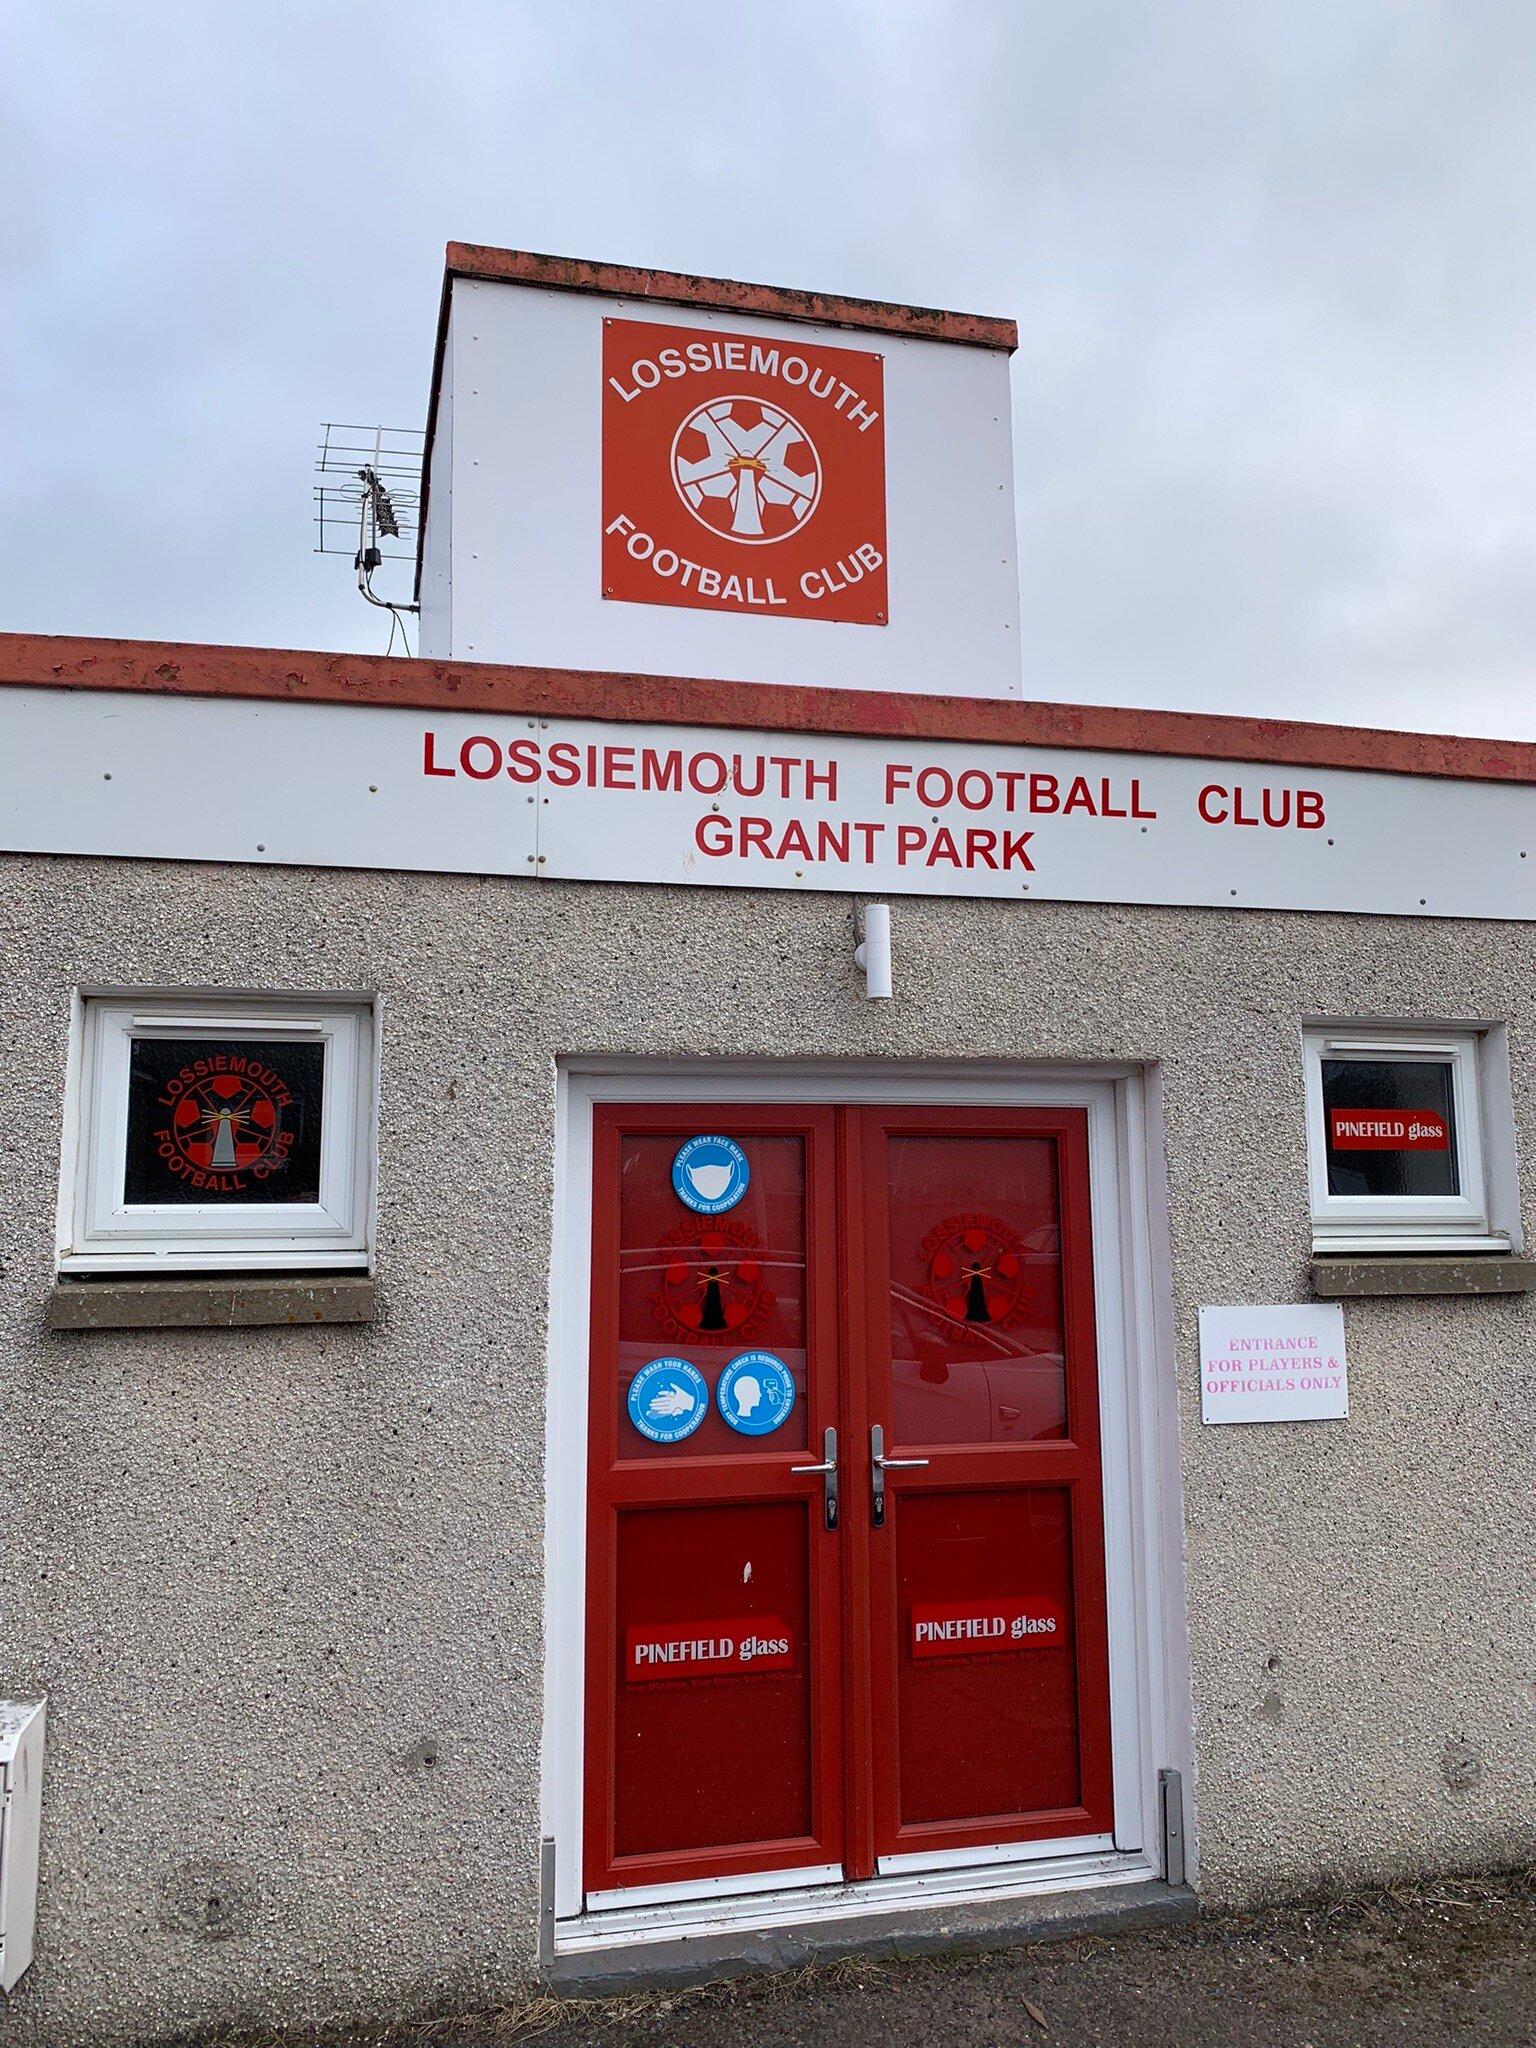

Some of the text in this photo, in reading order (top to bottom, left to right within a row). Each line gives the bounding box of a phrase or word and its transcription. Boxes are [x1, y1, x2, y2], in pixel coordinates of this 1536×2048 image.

[608, 342, 879, 432] LOSSIEMOUTH
[605, 514, 884, 605] FOOTBALL CLUB
[423, 732, 1326, 829] LOSSIEMOUTH FOOTBALL CLUB
[694, 813, 1036, 872] GRANT PARK
[158, 1056, 293, 1107] LOSSIEMOUTH
[1336, 1122, 1443, 1140] PINEFIELD glass
[153, 1129, 295, 1191] FOOTBALL CLUB
[676, 1137, 744, 1168] PLEASE WEAR FACE MASK
[678, 1182, 746, 1212] THANKS FOR COOPERATION
[914, 1211, 1029, 1262] OSSIEMO
[1228, 1336, 1318, 1351] ENTRANCE
[630, 1360, 702, 1402] PLEASE WASH YOUR HANDS
[731, 1355, 750, 1370] CHECK
[757, 1354, 784, 1372] REQUIRED
[786, 1389, 793, 1398] TO
[1206, 1376, 1342, 1393] OFFICIALS ONLY
[1207, 1356, 1339, 1373] FOR PLAYERS &
[637, 1402, 706, 1440] THANKS FOR COOPERATION
[915, 1615, 1056, 1641] PINEFIELD glass
[635, 1636, 789, 1664] PINEFIELD glass
